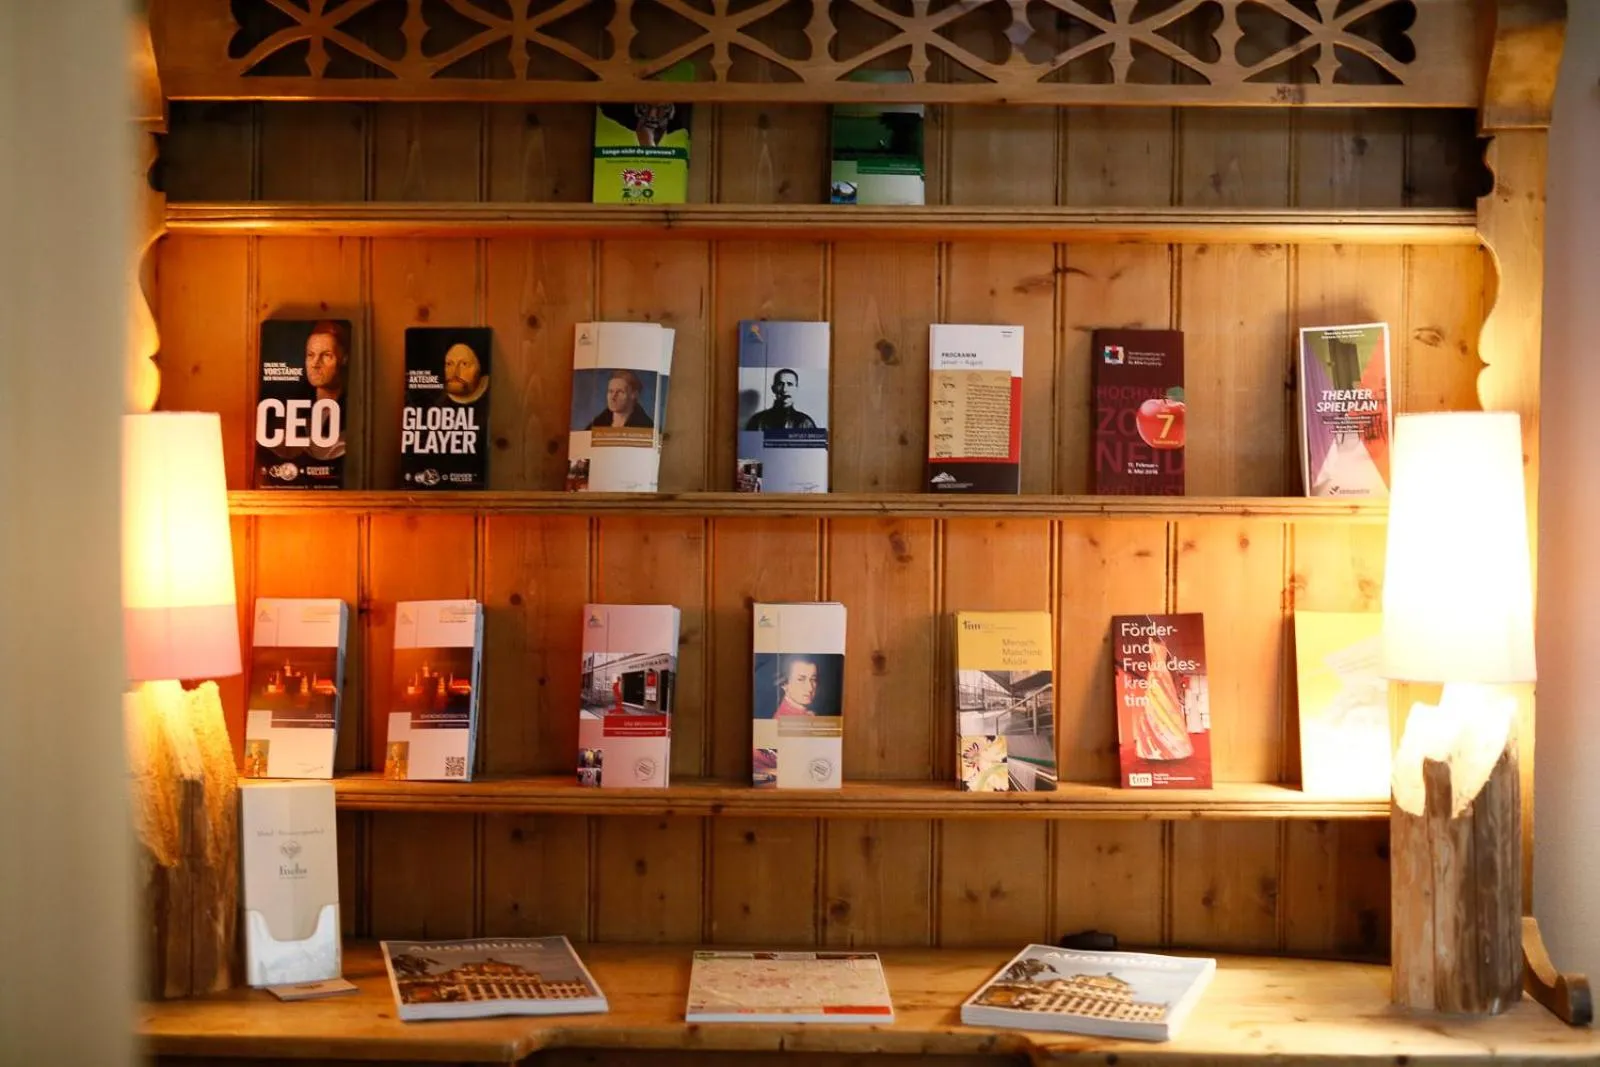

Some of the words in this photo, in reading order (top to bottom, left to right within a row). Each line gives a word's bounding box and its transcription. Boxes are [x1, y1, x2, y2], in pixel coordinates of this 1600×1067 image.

[263, 366, 304, 376] VORSTÄNDE
[1096, 385, 1168, 399] HOCHMU
[1321, 389, 1373, 401] THEATER
[1315, 400, 1379, 413] SPIELPLAN
[255, 397, 341, 448] CEO
[402, 406, 480, 430] GLOBAL
[1096, 408, 1138, 436] ZO
[1155, 413, 1175, 439] 7
[401, 430, 477, 454] PLAYER
[1121, 621, 1179, 637] Förder-
[1122, 640, 1153, 655] und
[1123, 658, 1201, 672] Freundes-
[1125, 694, 1152, 708] tim
[1131, 774, 1150, 786] tim
